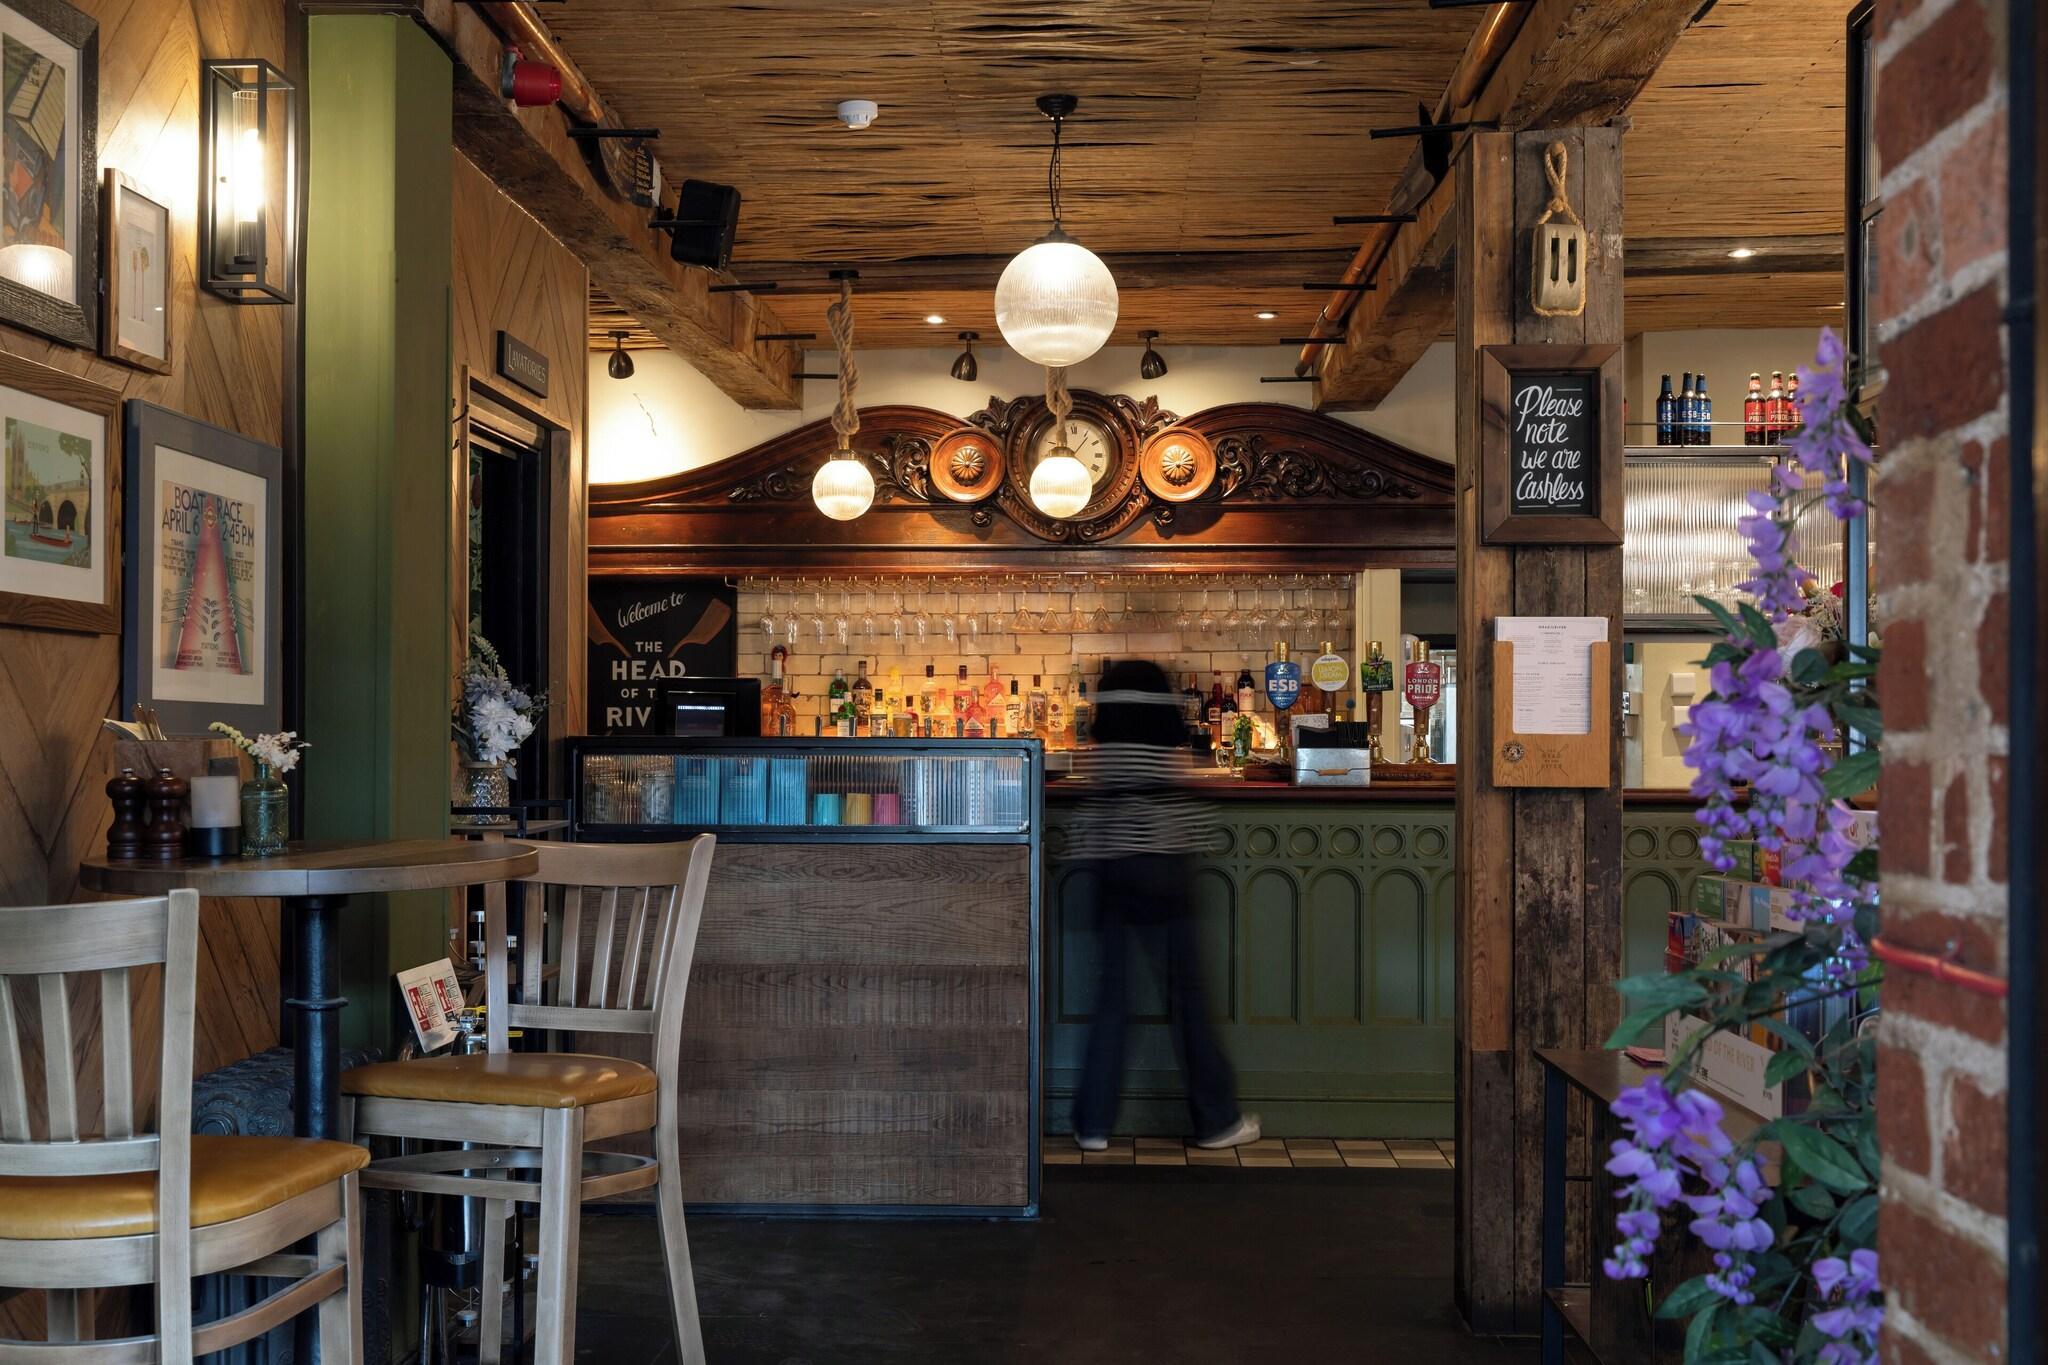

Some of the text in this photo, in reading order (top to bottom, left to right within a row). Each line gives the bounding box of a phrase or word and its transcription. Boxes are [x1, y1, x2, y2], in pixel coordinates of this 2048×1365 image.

[508, 343, 546, 384] LAVATORIES
[1515, 385, 1583, 432] Please
[1525, 418, 1569, 444] note
[1521, 448, 1581, 469] we are
[1516, 471, 1585, 504] Cashless
[174, 486, 243, 524] BOAT RACE
[162, 507, 191, 535] APRIL
[193, 515, 200, 536] 6
[618, 591, 687, 628] Welcome to
[635, 641, 663, 653] THE
[612, 660, 686, 681] HEAD
[620, 688, 639, 699] OF
[1268, 679, 1298, 692] ESB
[1407, 684, 1438, 694] PRIDE
[606, 707, 652, 727] RIV
